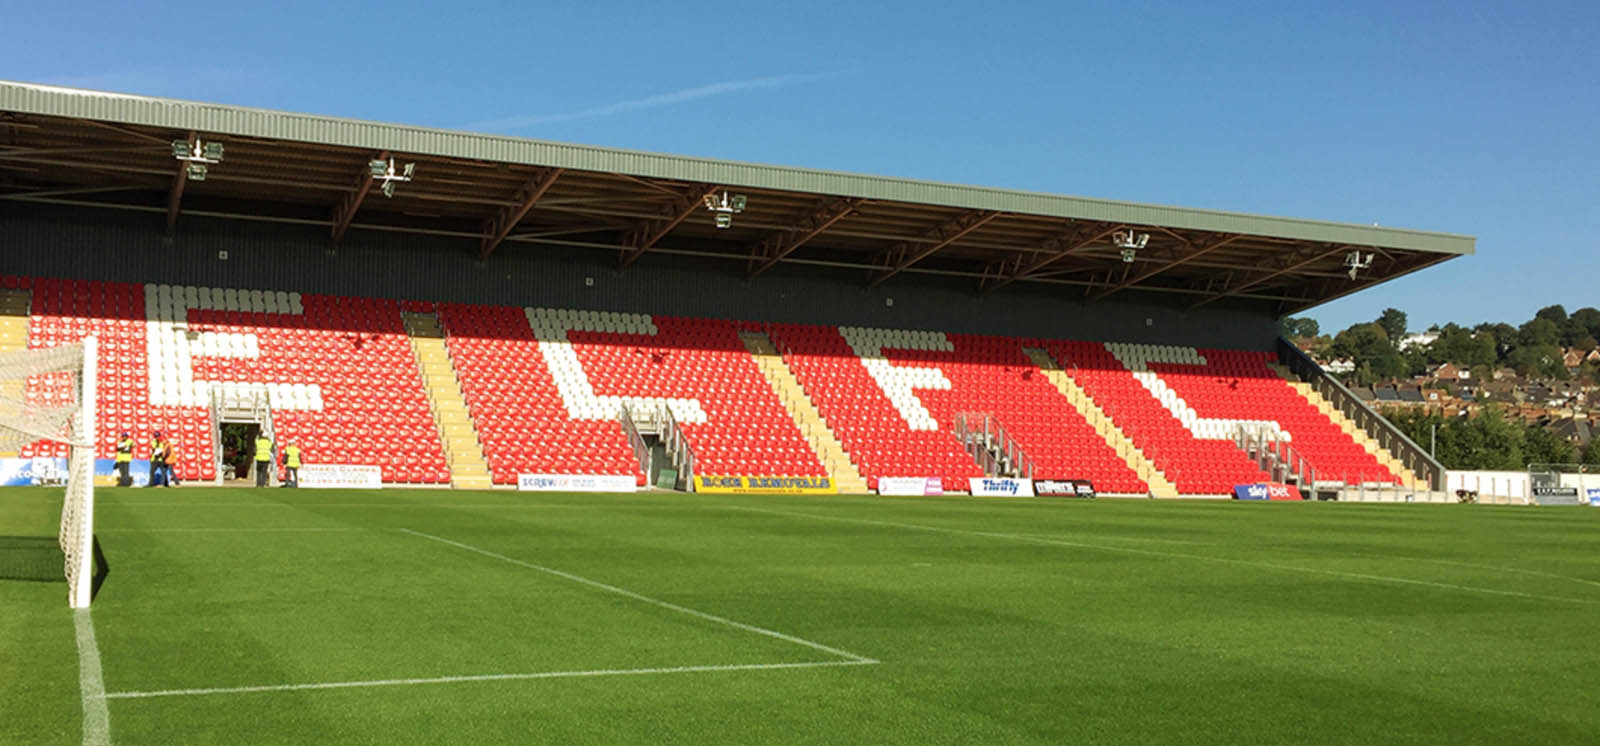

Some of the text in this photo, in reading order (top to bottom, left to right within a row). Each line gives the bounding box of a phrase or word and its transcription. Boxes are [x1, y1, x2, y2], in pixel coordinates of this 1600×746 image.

[983, 479, 1019, 494] Thrifty
[1248, 484, 1291, 499] sky bet
